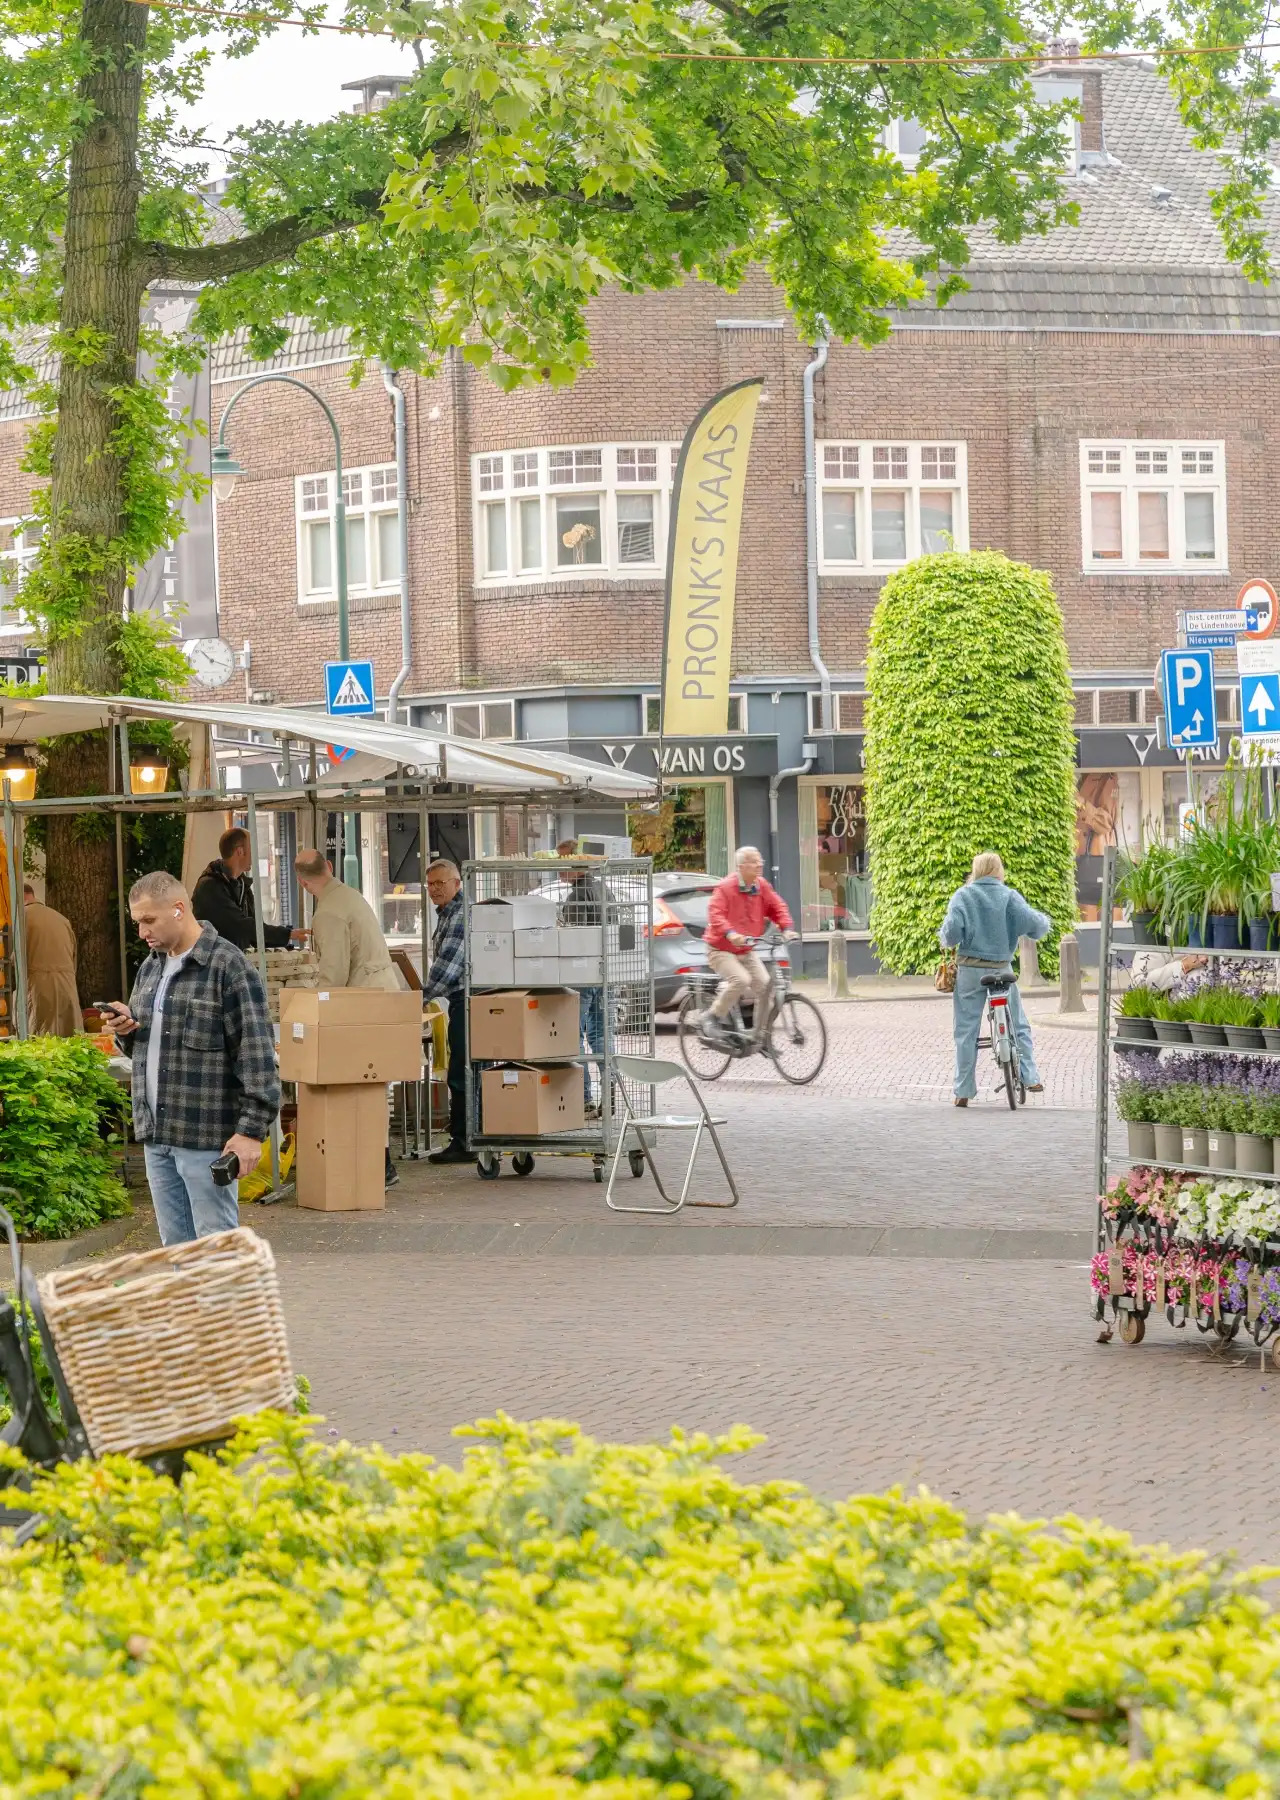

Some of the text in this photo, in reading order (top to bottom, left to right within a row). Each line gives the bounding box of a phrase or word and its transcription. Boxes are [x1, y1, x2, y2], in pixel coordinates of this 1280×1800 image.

[682, 424, 738, 700] PRONK'S KAAS
[1188, 636, 1234, 646] Nieuweweg
[1176, 658, 1202, 706] P
[652, 745, 746, 773] VAN OS
